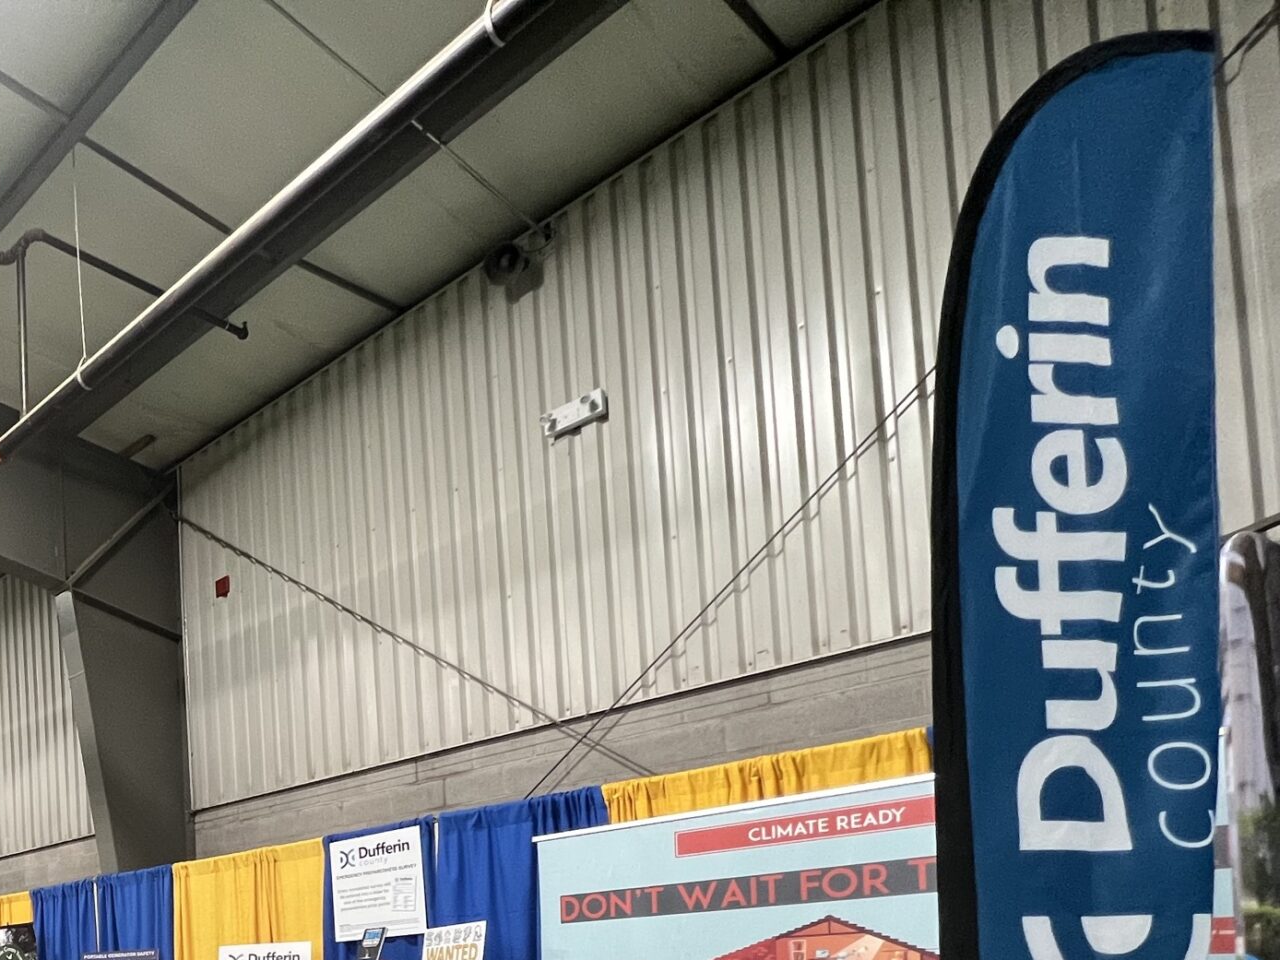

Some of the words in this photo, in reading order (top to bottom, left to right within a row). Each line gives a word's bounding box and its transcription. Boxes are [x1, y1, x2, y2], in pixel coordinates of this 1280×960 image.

[991, 236, 1133, 851] Dufferin
[1131, 502, 1215, 849] county
[358, 838, 410, 859] Dufferin
[748, 817, 829, 843] CLIMATE
[835, 806, 907, 831] READY
[561, 885, 664, 922] DON'T
[676, 874, 785, 912] WAIT
[800, 863, 890, 901] FOR
